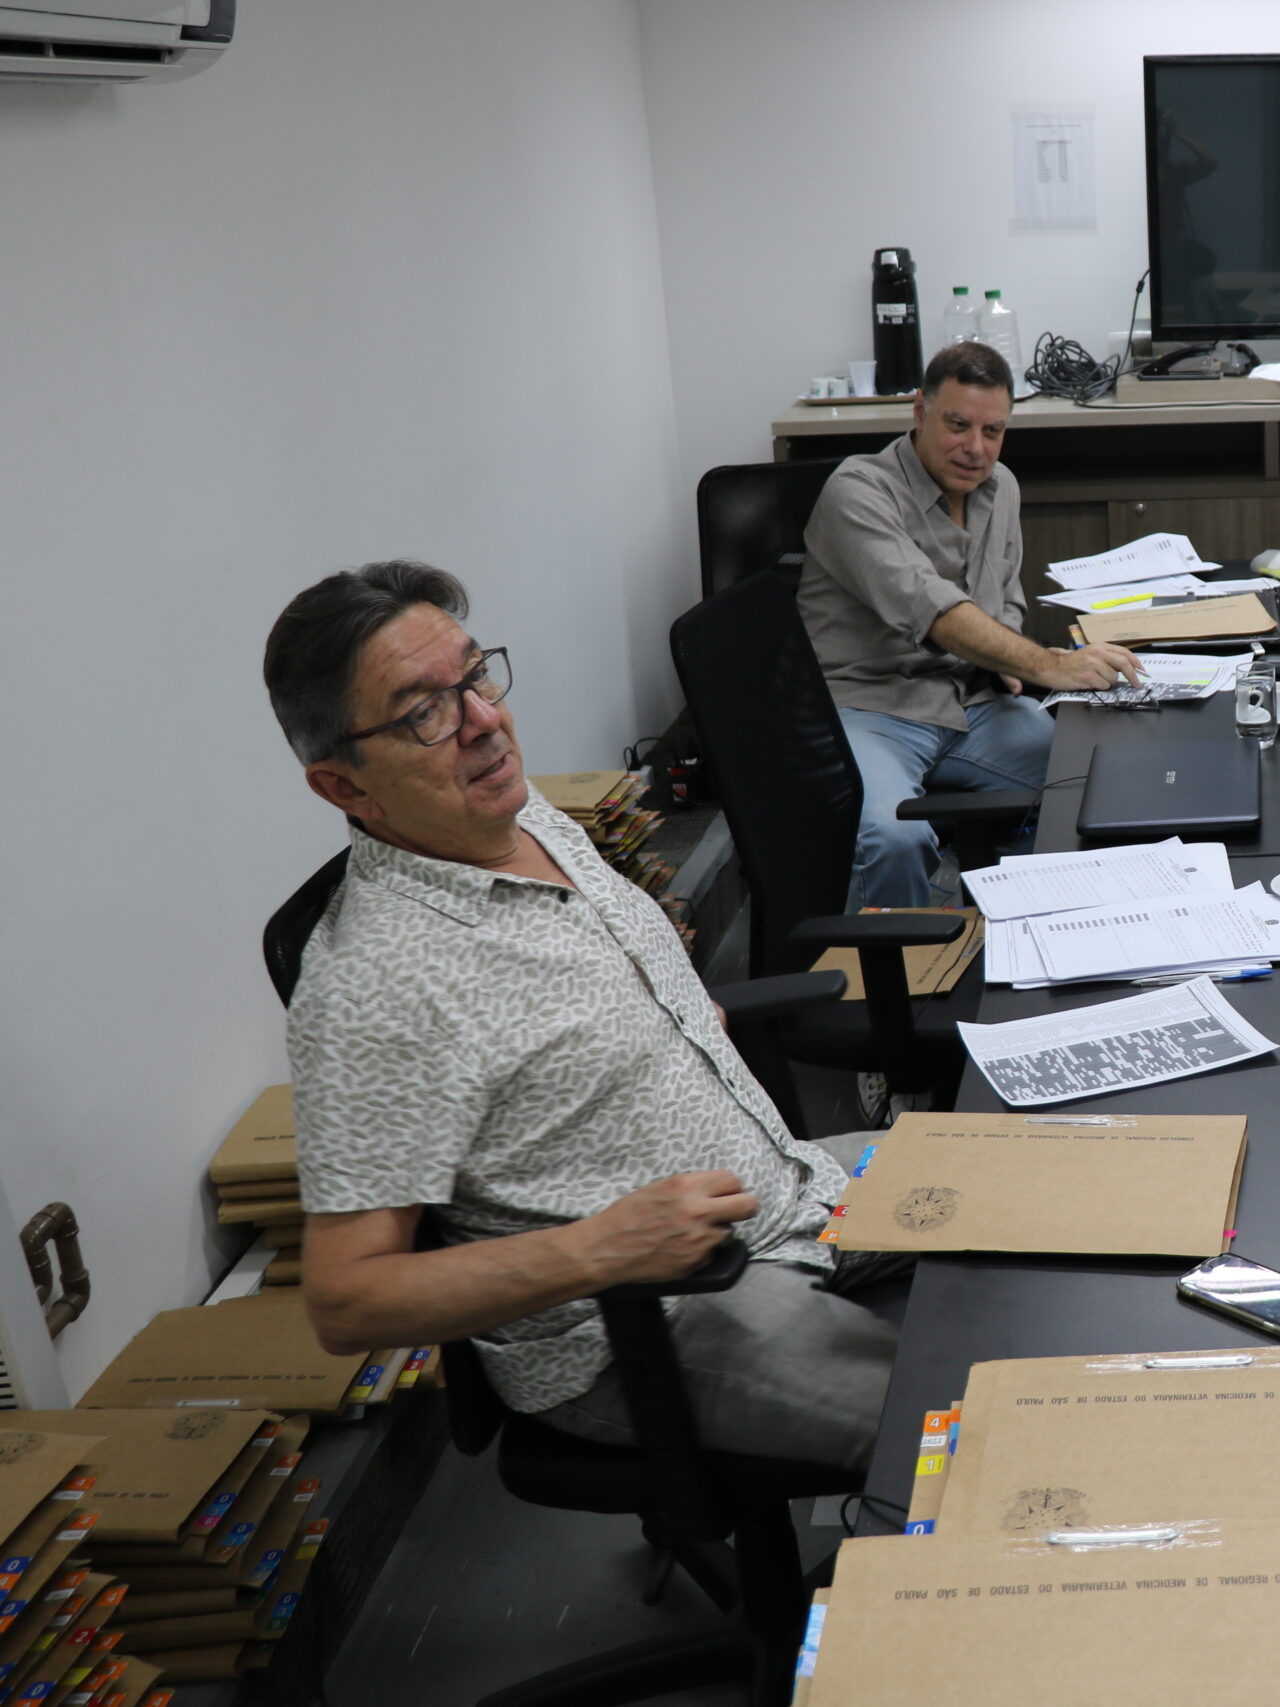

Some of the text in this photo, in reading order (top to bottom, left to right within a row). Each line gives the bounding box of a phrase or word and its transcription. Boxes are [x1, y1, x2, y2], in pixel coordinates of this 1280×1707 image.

[1076, 1396, 1088, 1404] DE
[1094, 1395, 1128, 1403] ESTADO
[1134, 1394, 1147, 1402] DO
[1153, 1393, 1208, 1402] VETERINÁRIA
[1215, 1392, 1257, 1400] MEDICINA
[1263, 1391, 1275, 1399] DE
[1016, 1398, 1044, 1406] PAULO
[1050, 1396, 1069, 1405] SÃO
[930, 1416, 941, 1428] 4
[927, 1458, 935, 1471] 1
[1136, 1578, 1186, 1589] MEDICINA
[1195, 1576, 1209, 1587] DE
[1218, 1574, 1269, 1585] REGIONAL
[990, 1584, 1030, 1596] ESTADO
[1038, 1583, 1053, 1594] DO
[1061, 1581, 1128, 1592] VETERINÁRIA
[894, 1590, 928, 1600] PAULO
[936, 1588, 958, 1600] SÃO
[967, 1587, 981, 1597] DE
